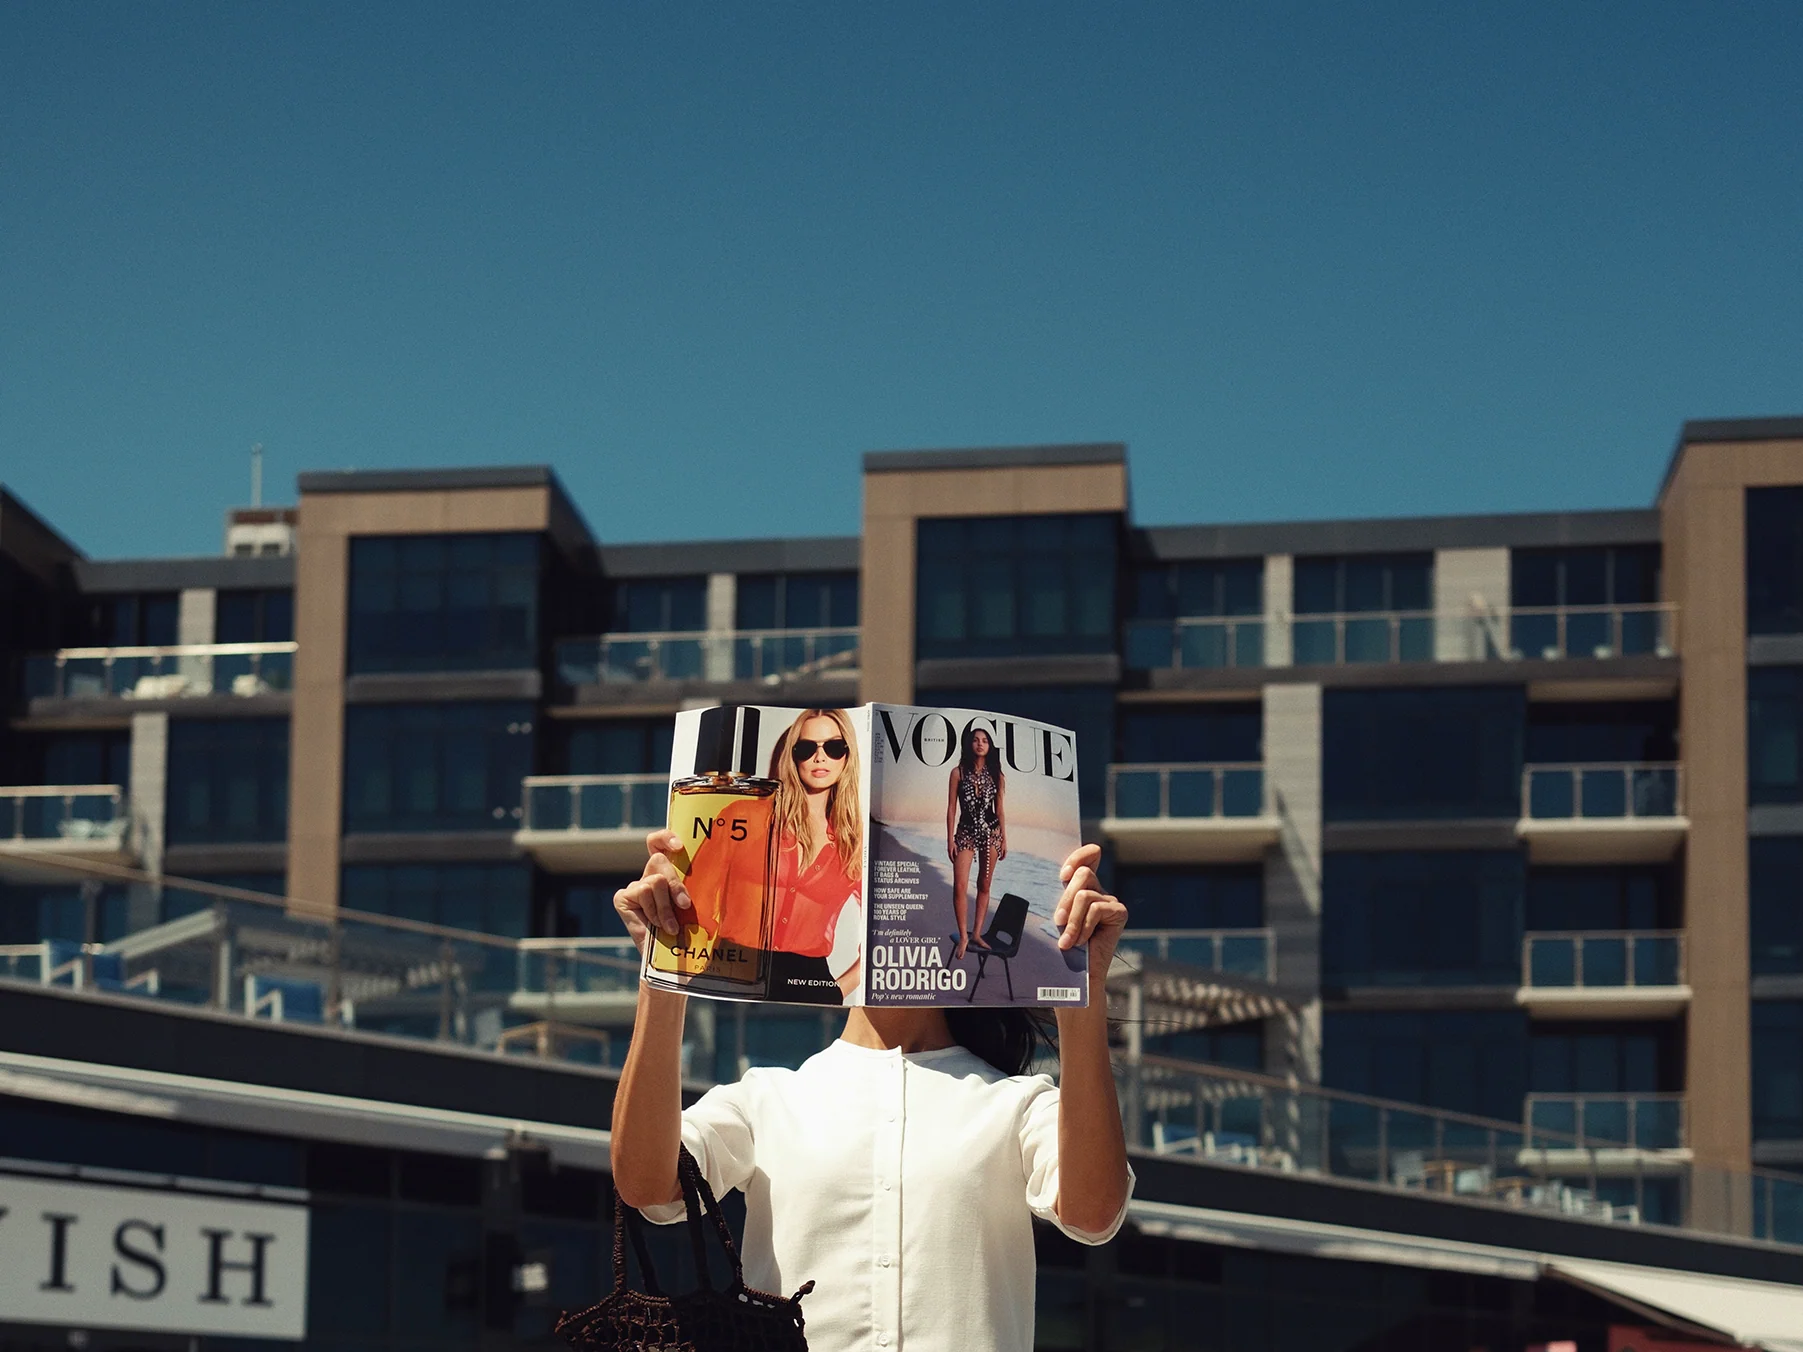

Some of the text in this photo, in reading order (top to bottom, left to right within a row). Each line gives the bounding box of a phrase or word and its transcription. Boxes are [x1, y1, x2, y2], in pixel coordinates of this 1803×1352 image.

[876, 709, 1074, 782] VOGUE
[730, 818, 748, 841] 5
[885, 929, 912, 937] definitely
[670, 945, 748, 963] CHANEL
[872, 945, 943, 968] OLIVIA
[694, 964, 721, 973] PARIS
[787, 978, 840, 988] NEW EDITION
[871, 968, 967, 991] RODRIGO
[871, 993, 890, 1001] Pop's
[0, 1206, 275, 1308] ISH
